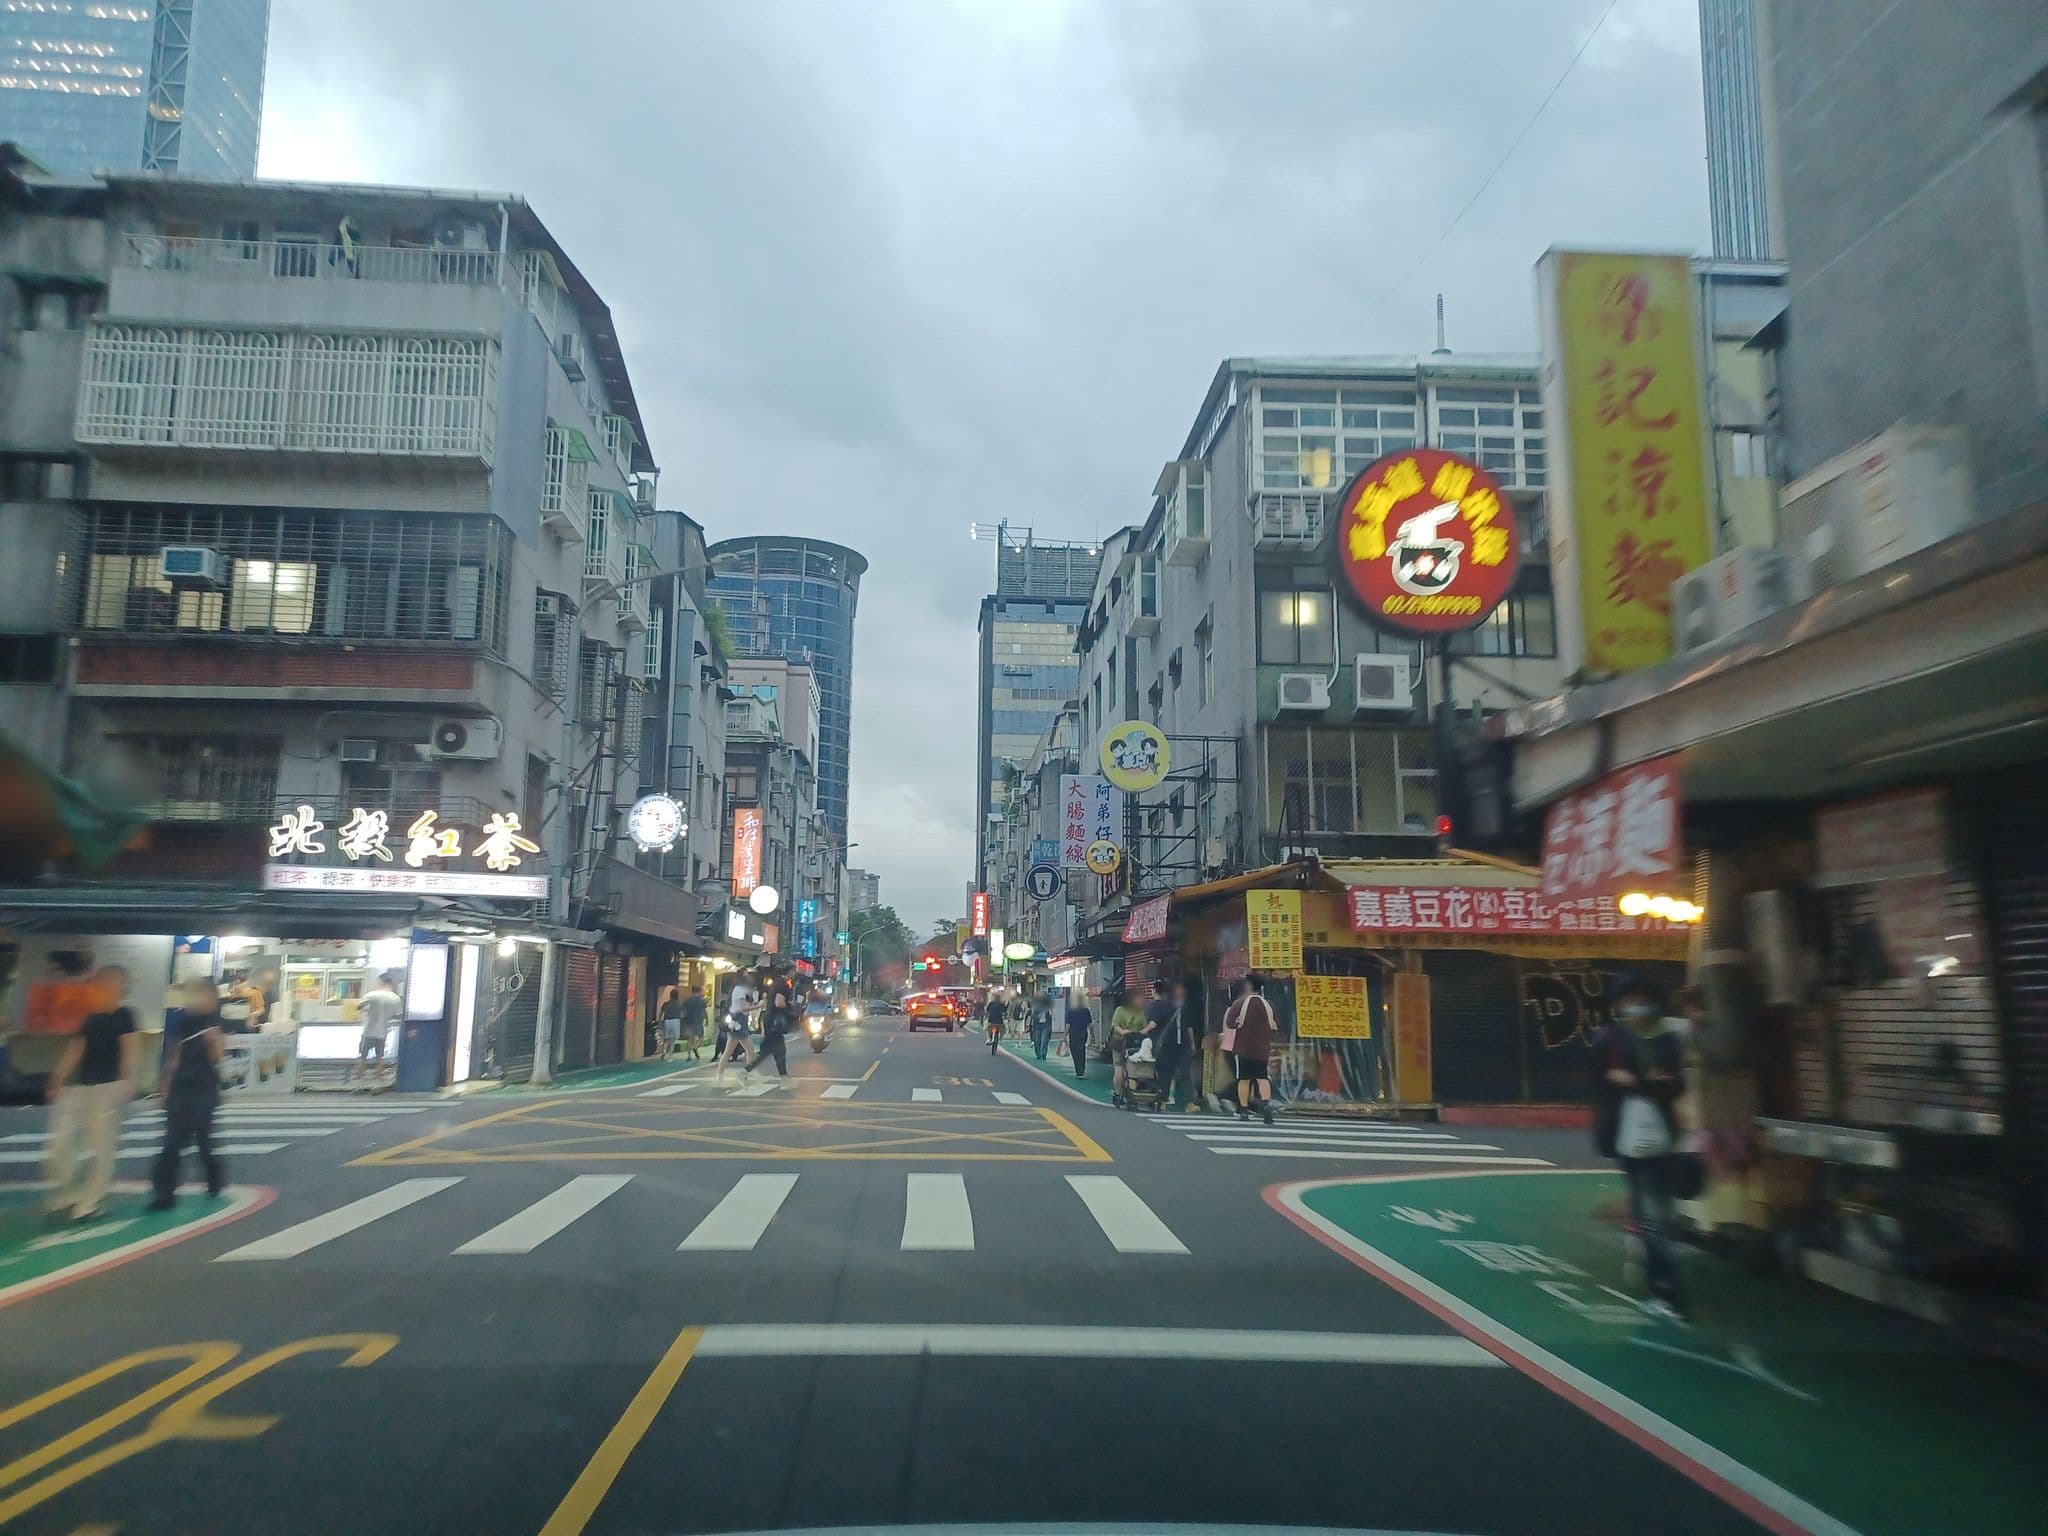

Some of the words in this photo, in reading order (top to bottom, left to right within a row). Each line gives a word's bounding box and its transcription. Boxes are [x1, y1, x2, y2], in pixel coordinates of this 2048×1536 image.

[1065, 779, 1087, 863] 大腸麵線
[1095, 783, 1113, 840] 阿弟仔
[1266, 891, 1283, 910] 熱
[1353, 887, 1473, 928] 嘉義豆花
[1299, 977, 1322, 993] 外送
[1299, 996, 1364, 1009] 2742-5472
